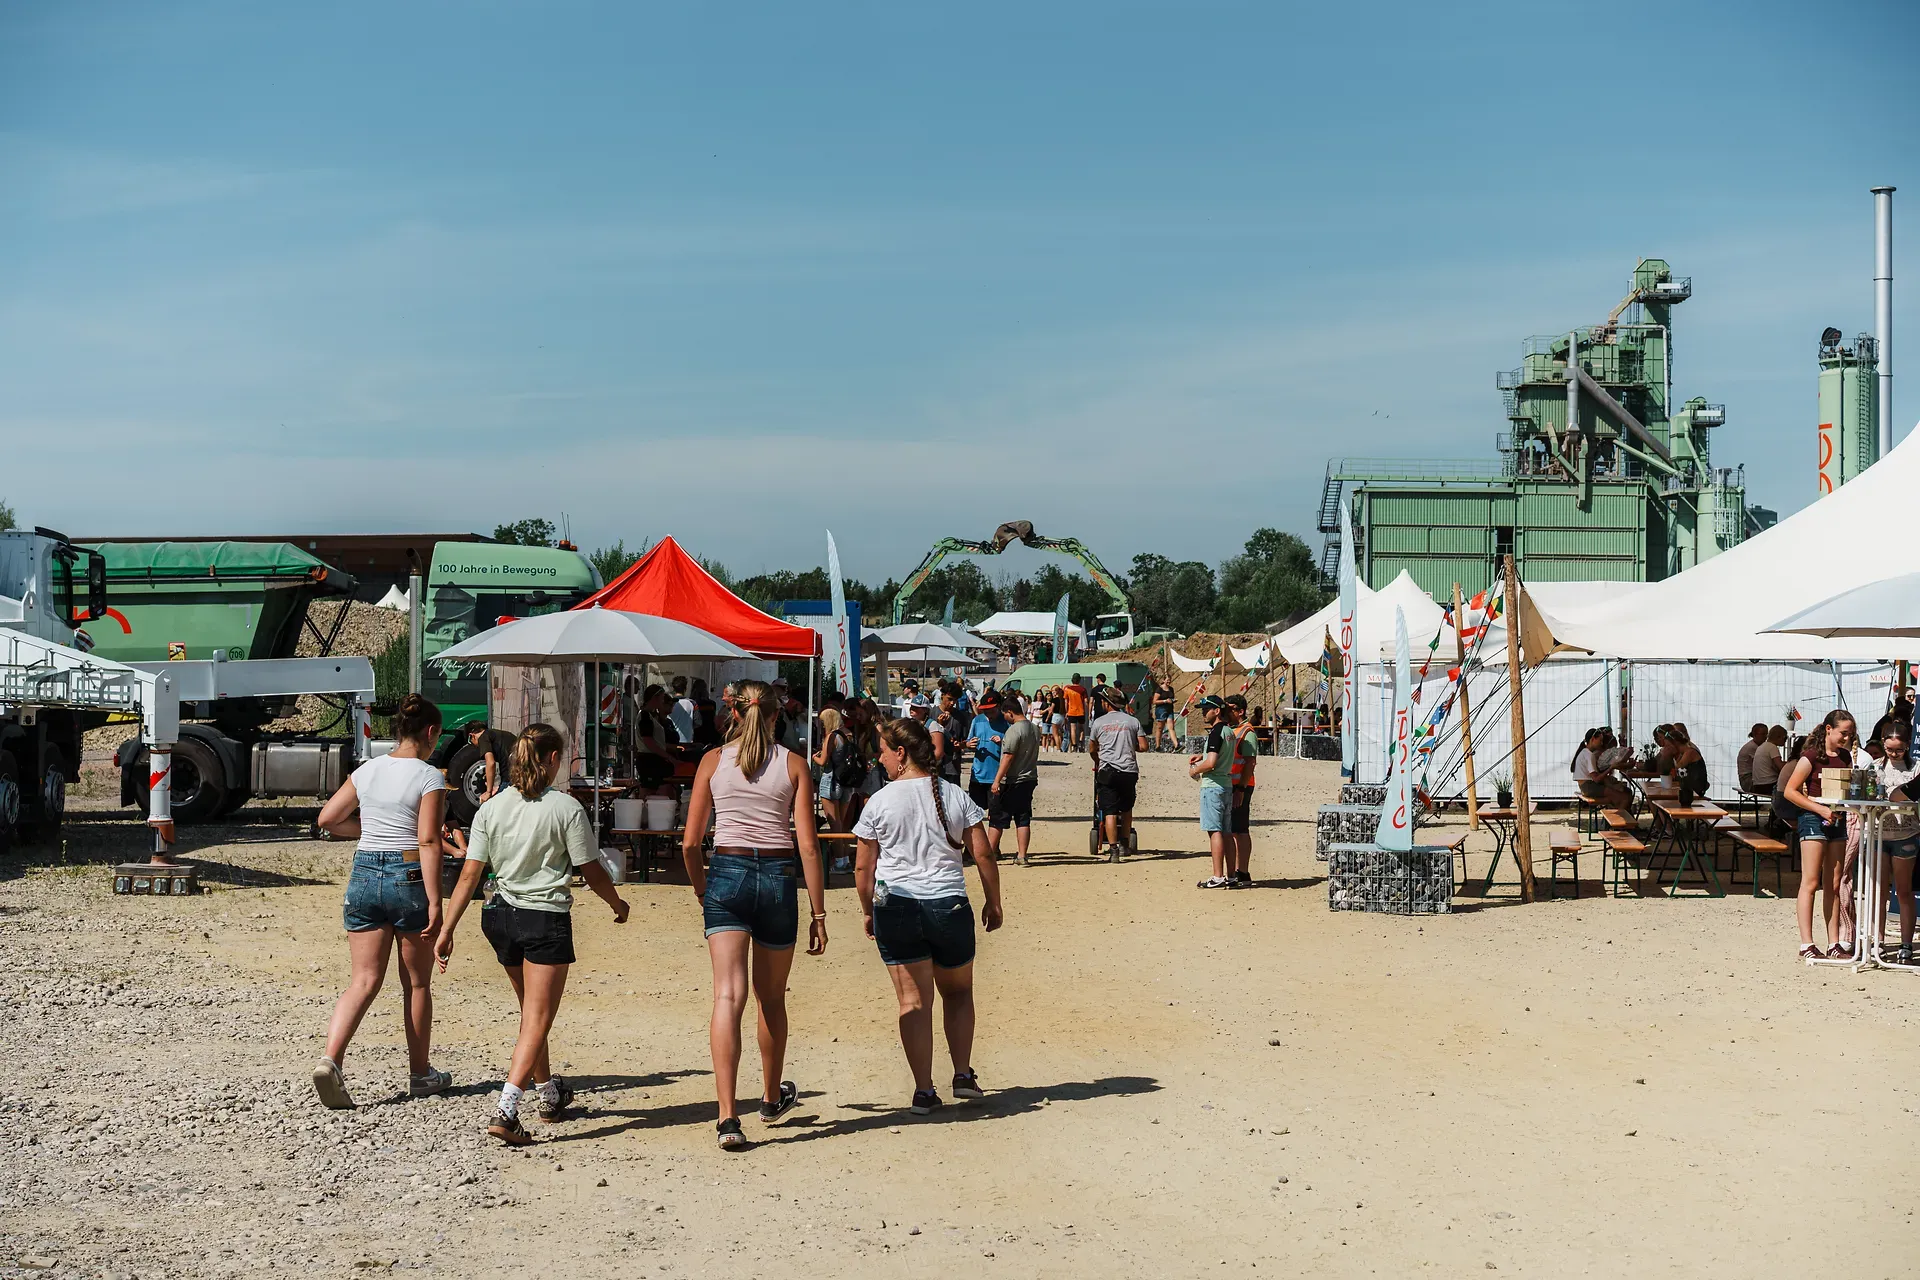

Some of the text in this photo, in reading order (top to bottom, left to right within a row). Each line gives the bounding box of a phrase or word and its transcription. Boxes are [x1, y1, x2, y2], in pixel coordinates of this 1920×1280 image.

[438, 564, 557, 576] 100 Jahre in Bewegung
[230, 650, 243, 659] 709
